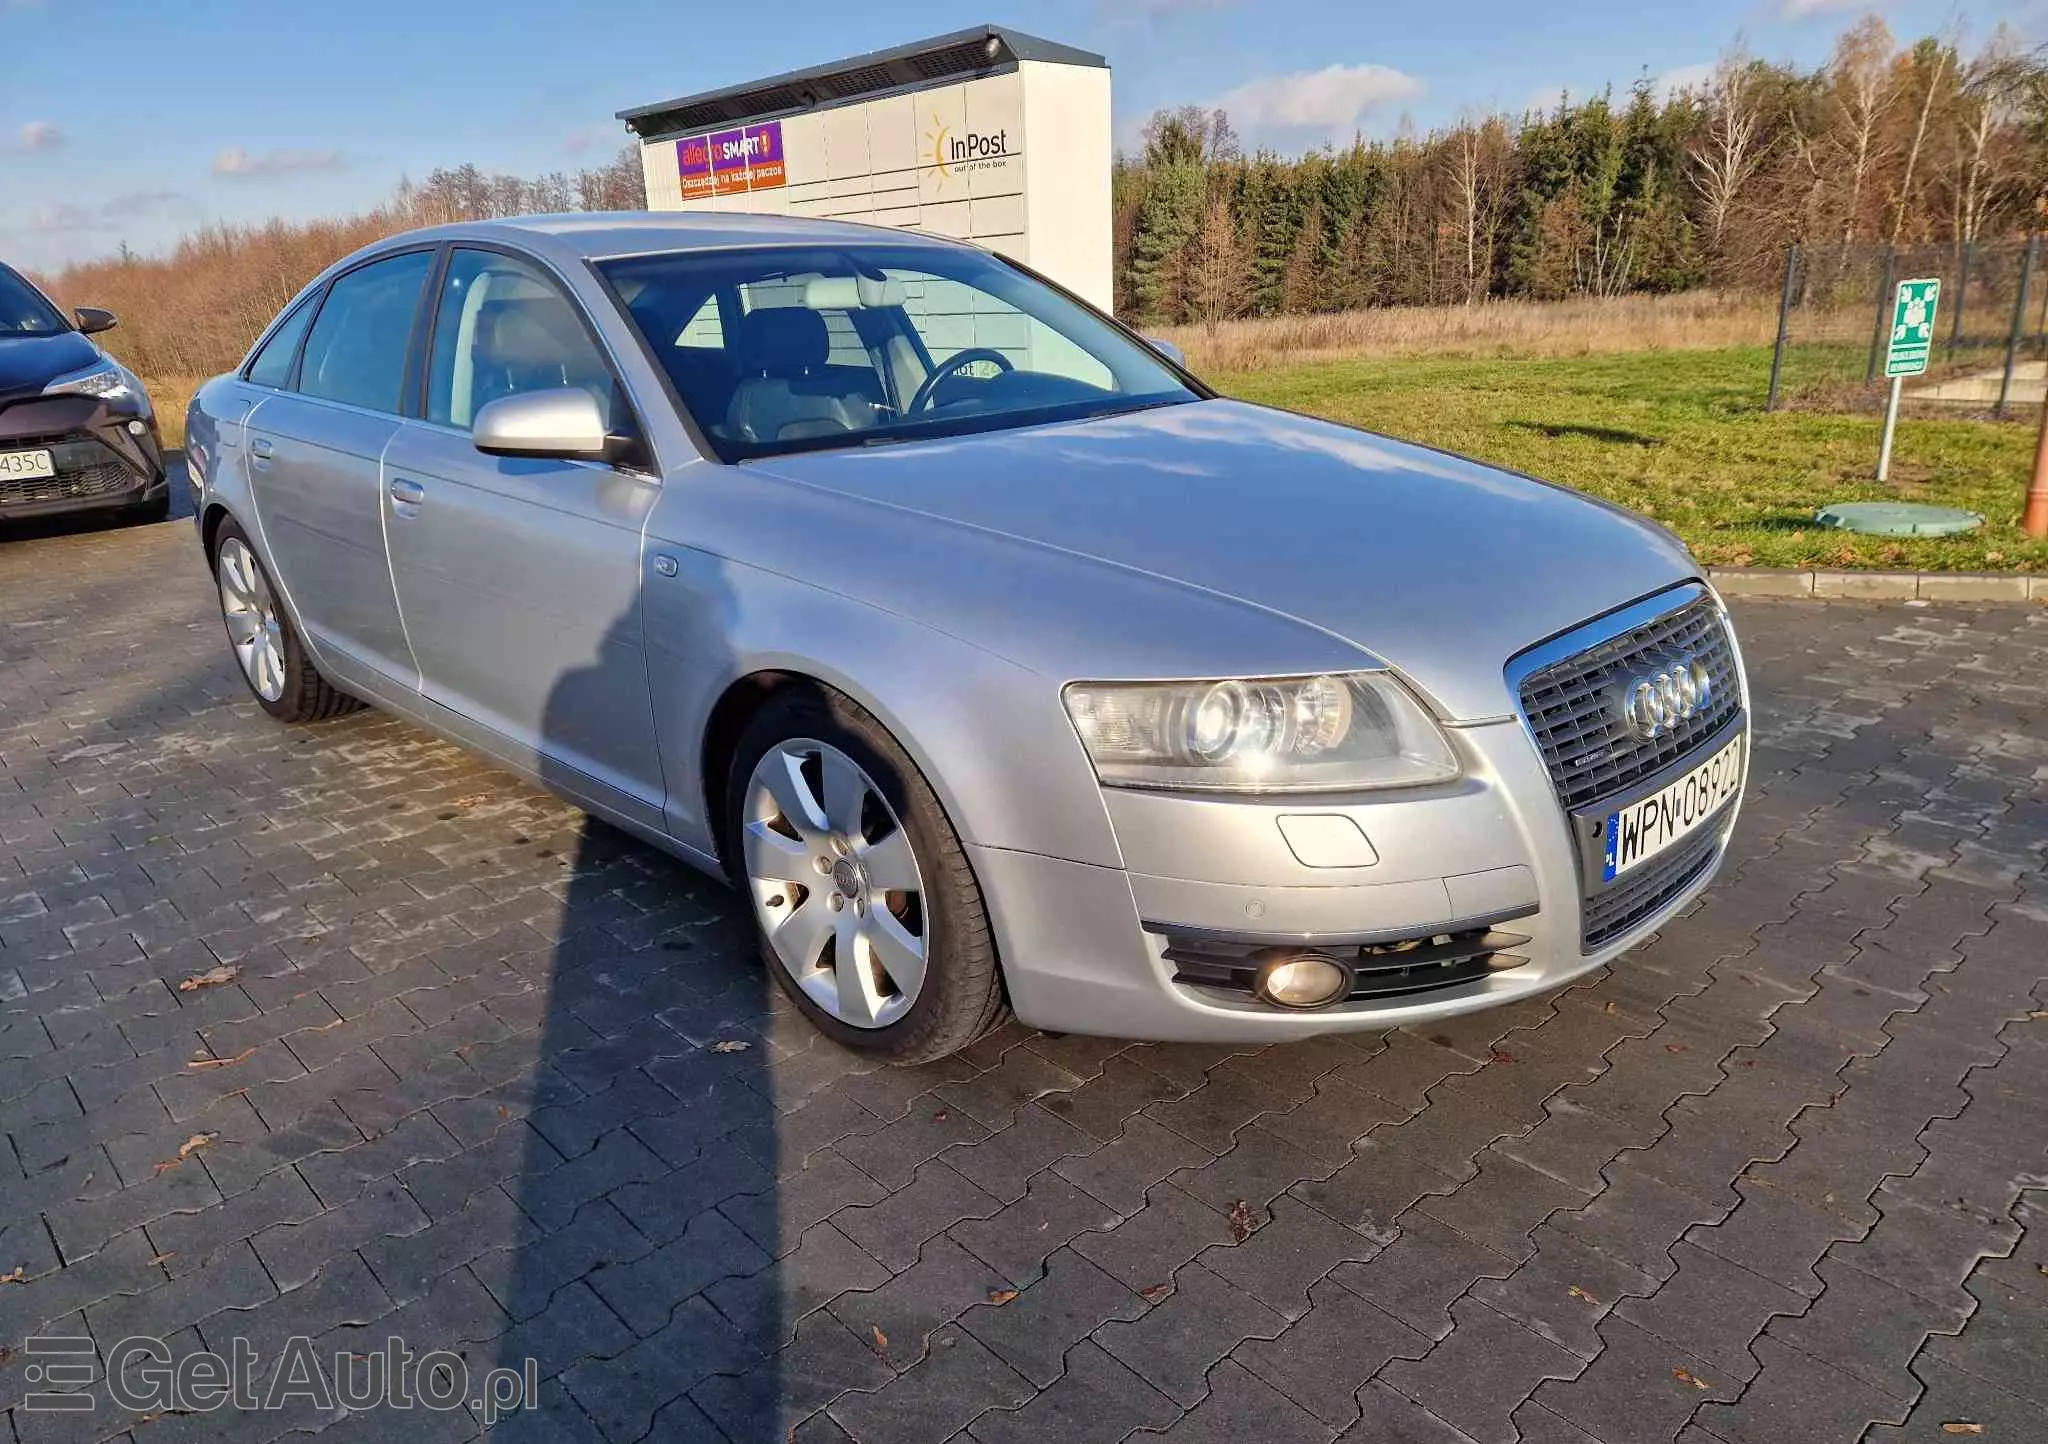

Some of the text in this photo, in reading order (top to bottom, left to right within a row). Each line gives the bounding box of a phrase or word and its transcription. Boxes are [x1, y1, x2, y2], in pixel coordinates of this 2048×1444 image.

[950, 129, 1007, 160] InPost
[954, 164, 967, 173] out
[978, 161, 991, 170] the
[993, 160, 1008, 168] box
[0, 453, 48, 473] 435C
[1621, 786, 1676, 865] WPN
